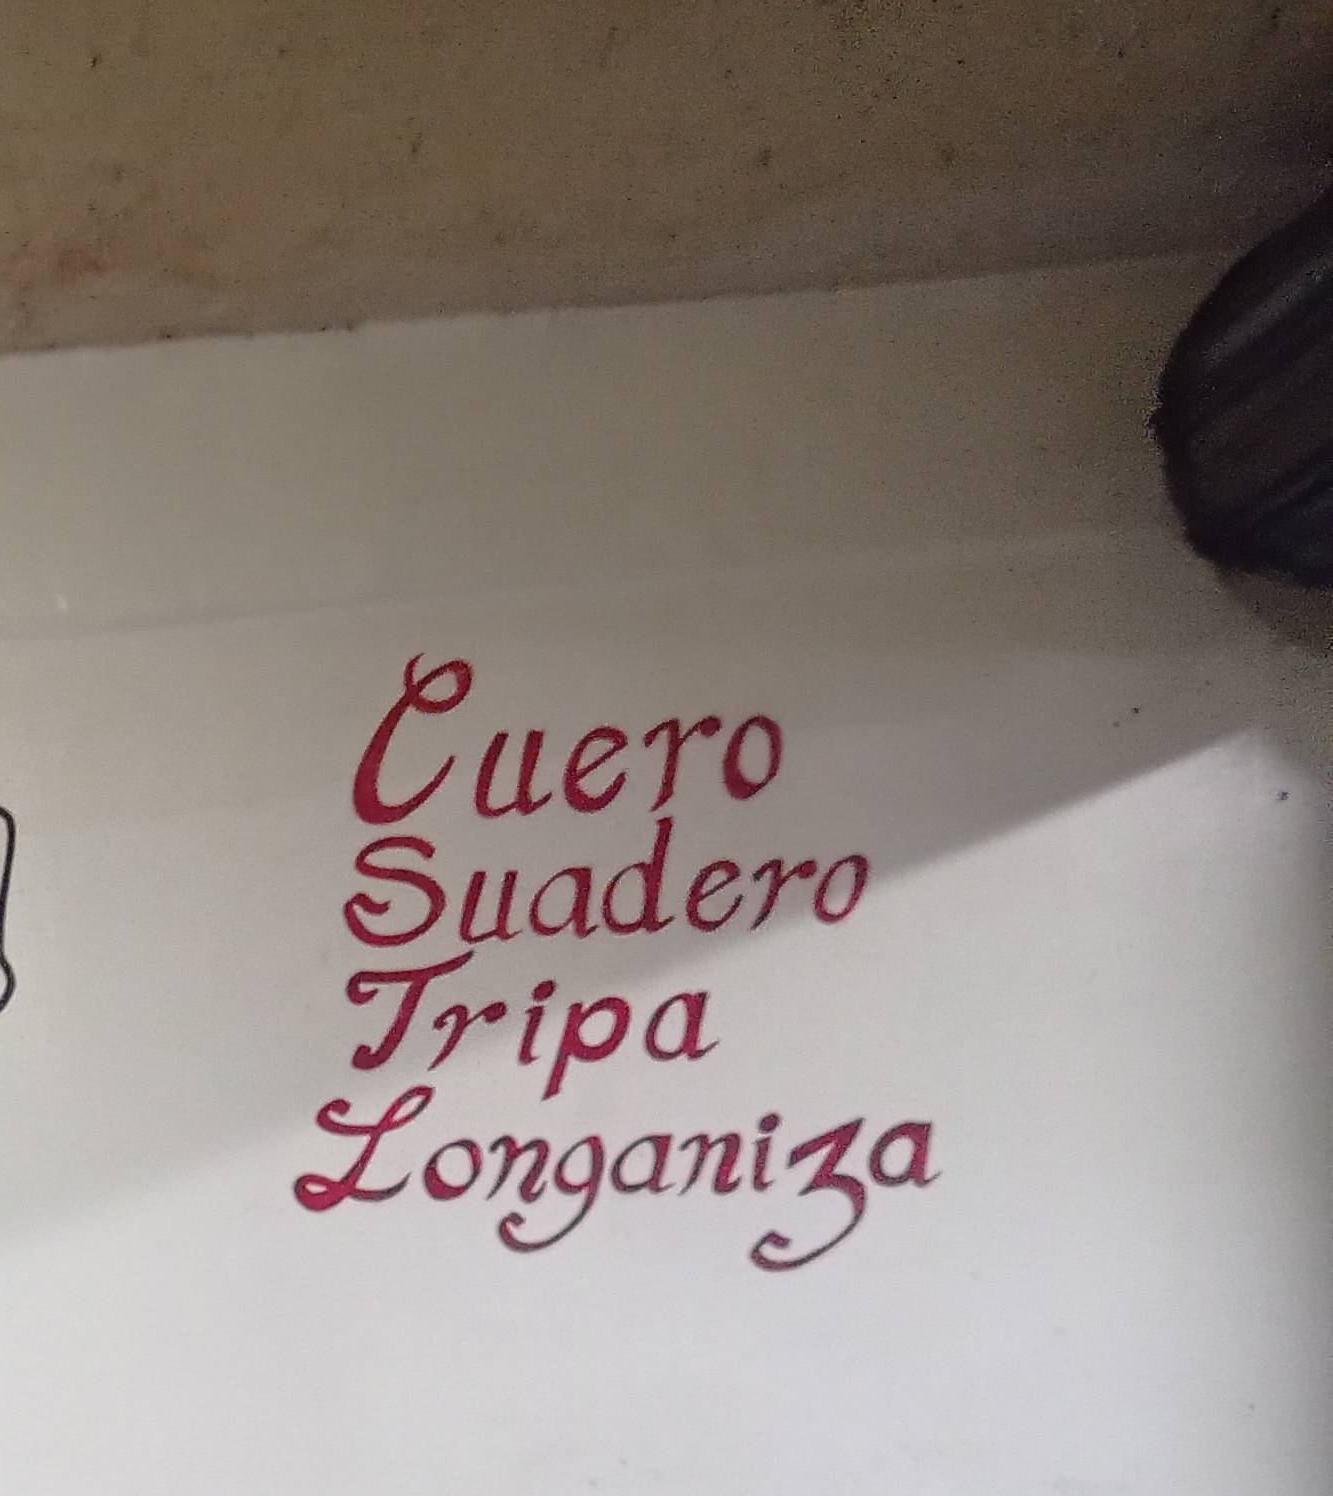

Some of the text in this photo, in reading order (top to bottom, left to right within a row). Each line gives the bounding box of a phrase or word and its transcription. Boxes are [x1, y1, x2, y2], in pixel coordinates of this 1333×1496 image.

[352, 652, 784, 825] Cuero
[342, 816, 870, 947] Suadero
[345, 950, 720, 1102] Tripa
[293, 1085, 943, 1273] Longaniza
